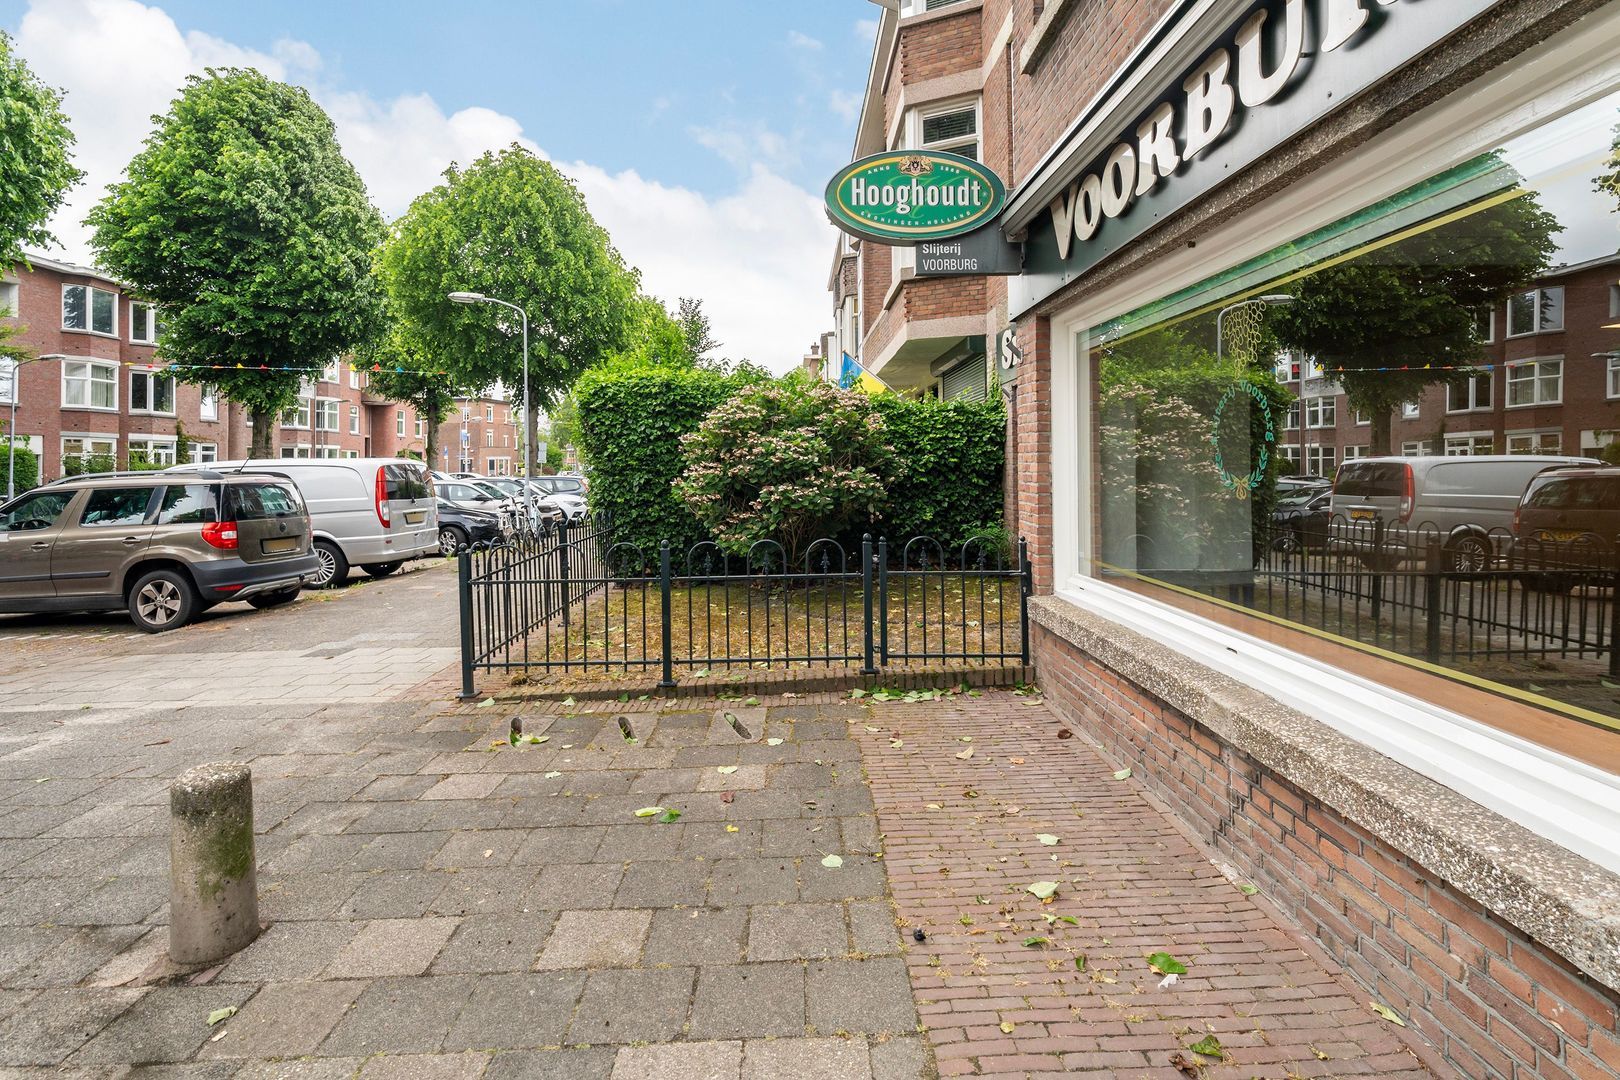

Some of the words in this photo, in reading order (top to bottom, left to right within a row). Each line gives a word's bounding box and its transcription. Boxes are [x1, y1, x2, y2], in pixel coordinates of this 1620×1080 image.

[867, 165, 890, 175] ANNO
[852, 177, 981, 214] Hooghoudt
[922, 243, 961, 256] Slijterij
[922, 259, 978, 271] VOORBURG
